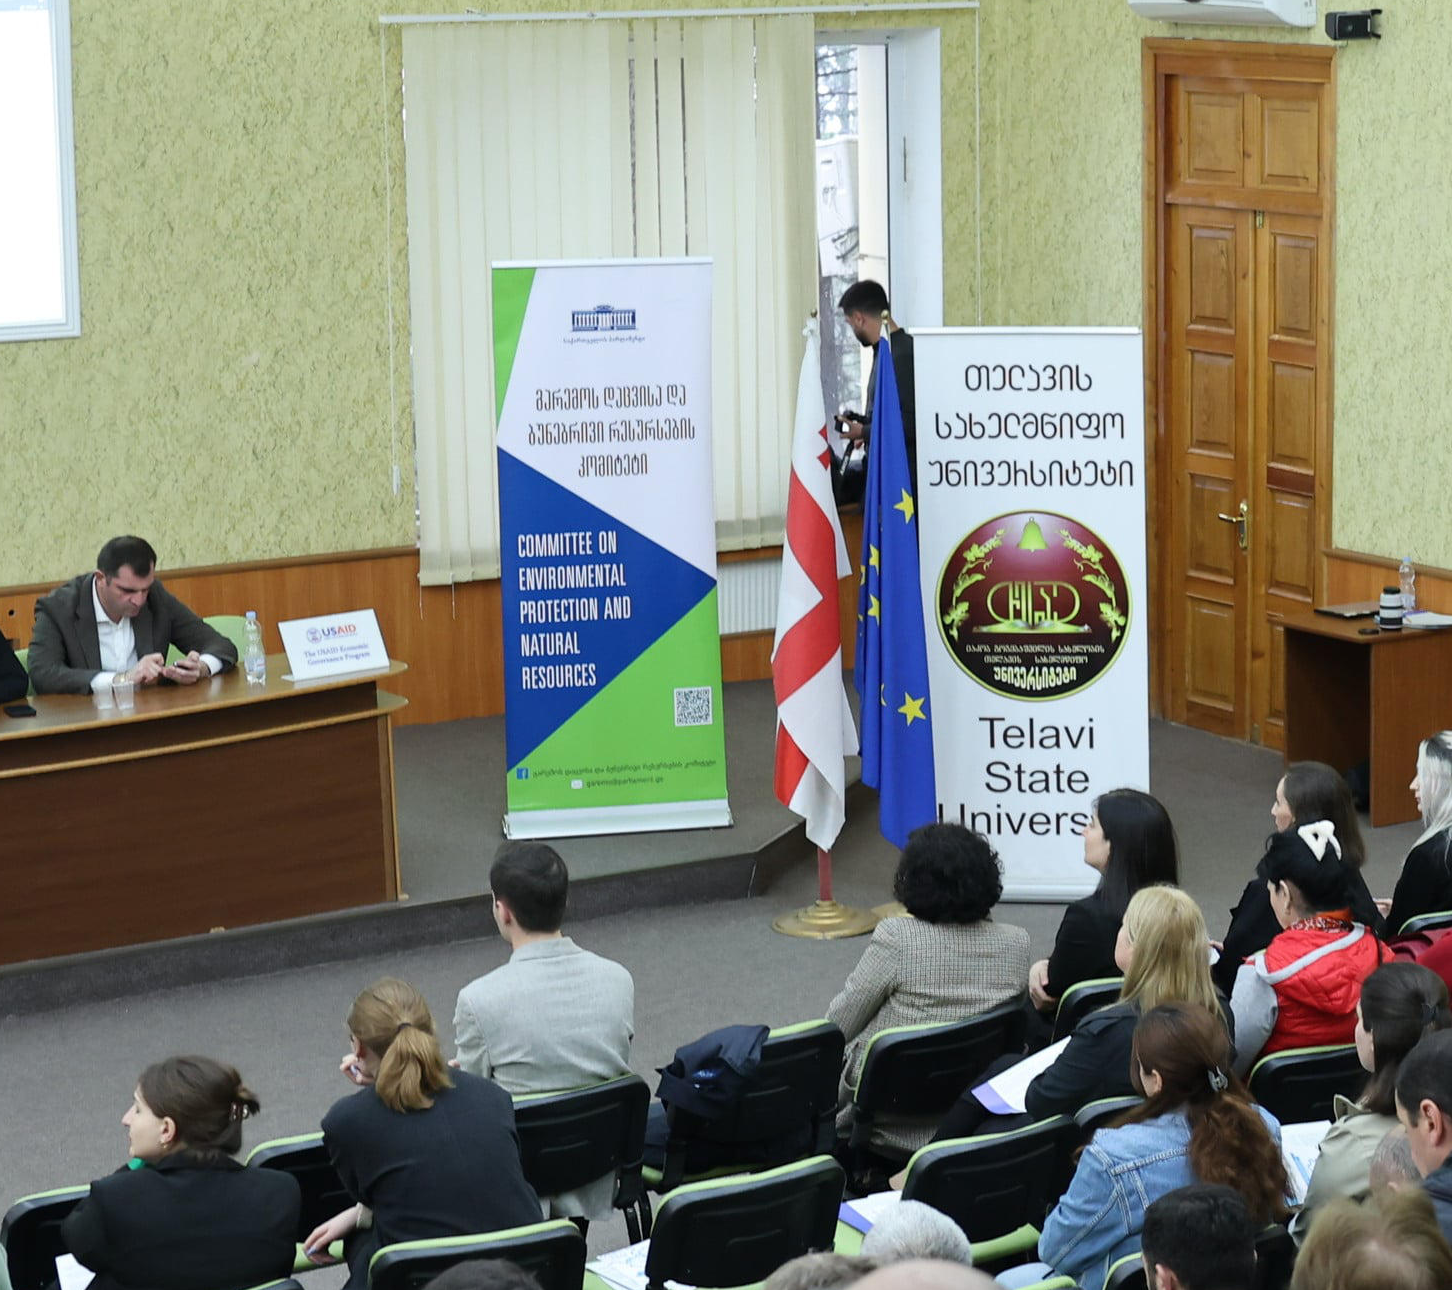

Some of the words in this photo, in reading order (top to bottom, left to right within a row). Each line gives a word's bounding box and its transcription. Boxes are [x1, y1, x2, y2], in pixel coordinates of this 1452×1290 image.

[964, 364, 1093, 392] თელავის
[536, 387, 599, 412] გარემოს
[603, 385, 662, 408] დაცვისა
[666, 384, 687, 406] და
[528, 421, 604, 446] ბუნებრივი
[608, 418, 696, 443] რესურსების
[935, 412, 1125, 440] სახელმწიფო
[578, 453, 648, 478] კომიტეტი
[928, 460, 1134, 488] უნივერსიტეტი
[517, 531, 593, 558] COMMITTEE
[598, 530, 617, 554] ON
[518, 563, 627, 591] ENVIRONMENTAL
[520, 597, 598, 624] PROTECTION
[603, 595, 631, 620] AND
[321, 624, 356, 637] USAID
[520, 631, 580, 657] NATURAL
[522, 663, 597, 690] RESOURCES
[978, 717, 1095, 749] Telavi
[985, 761, 1089, 794] State
[938, 803, 1094, 836] Univers
